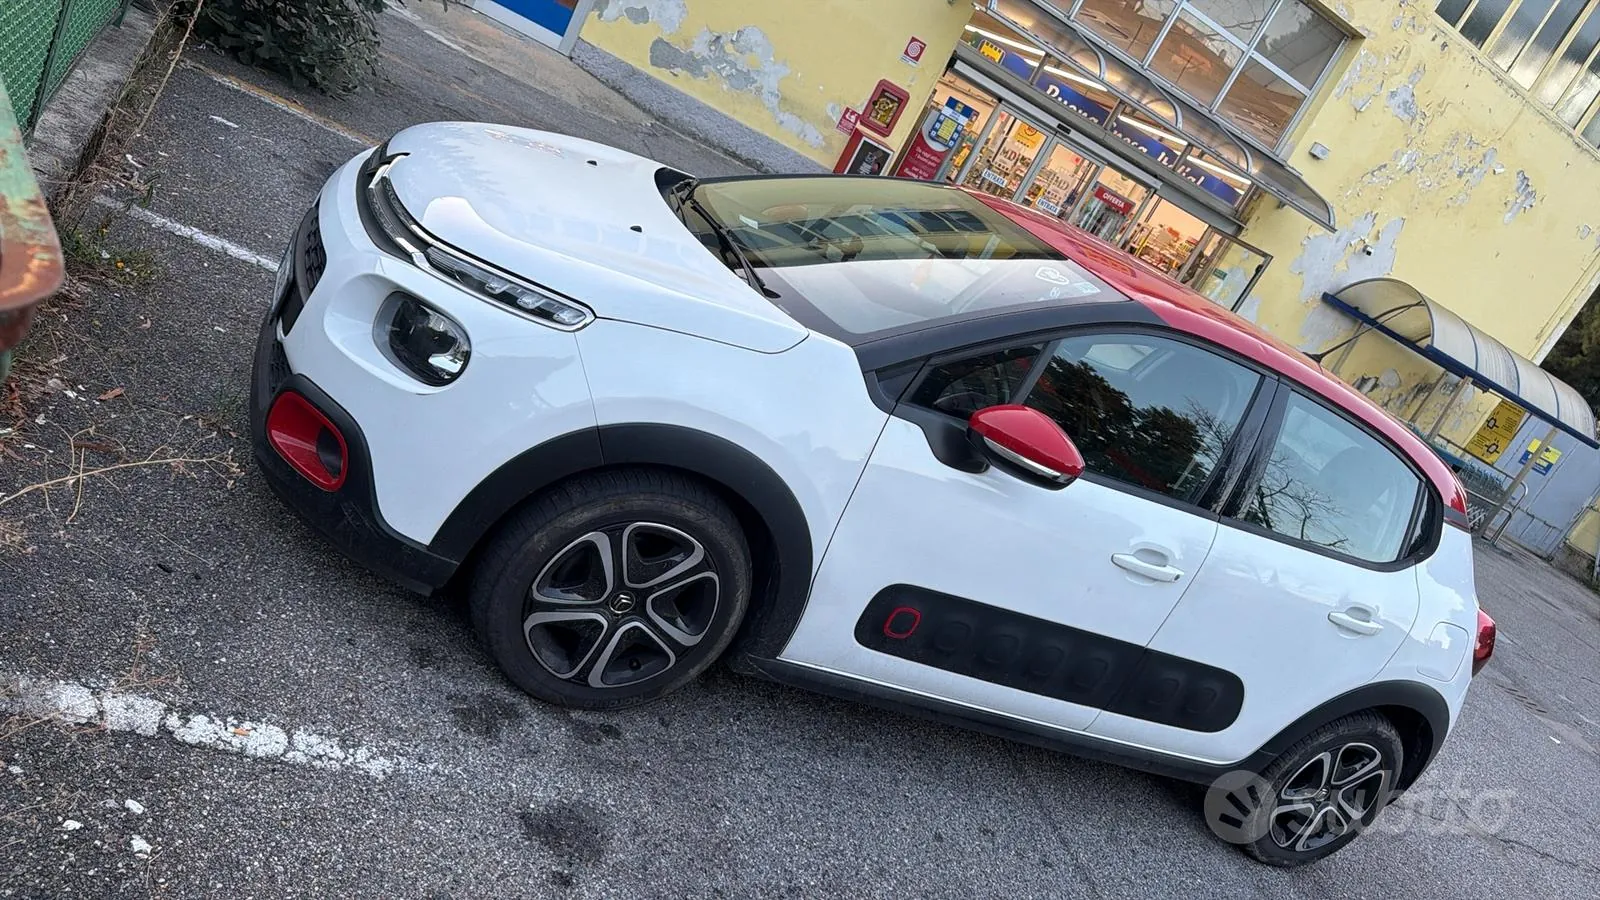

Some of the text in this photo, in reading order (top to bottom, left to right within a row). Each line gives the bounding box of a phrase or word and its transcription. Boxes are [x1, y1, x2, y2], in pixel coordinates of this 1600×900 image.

[983, 169, 1006, 187] ENTRATA
[1037, 199, 1059, 215] ENTRATA
[1102, 192, 1125, 209] OFFERTA
